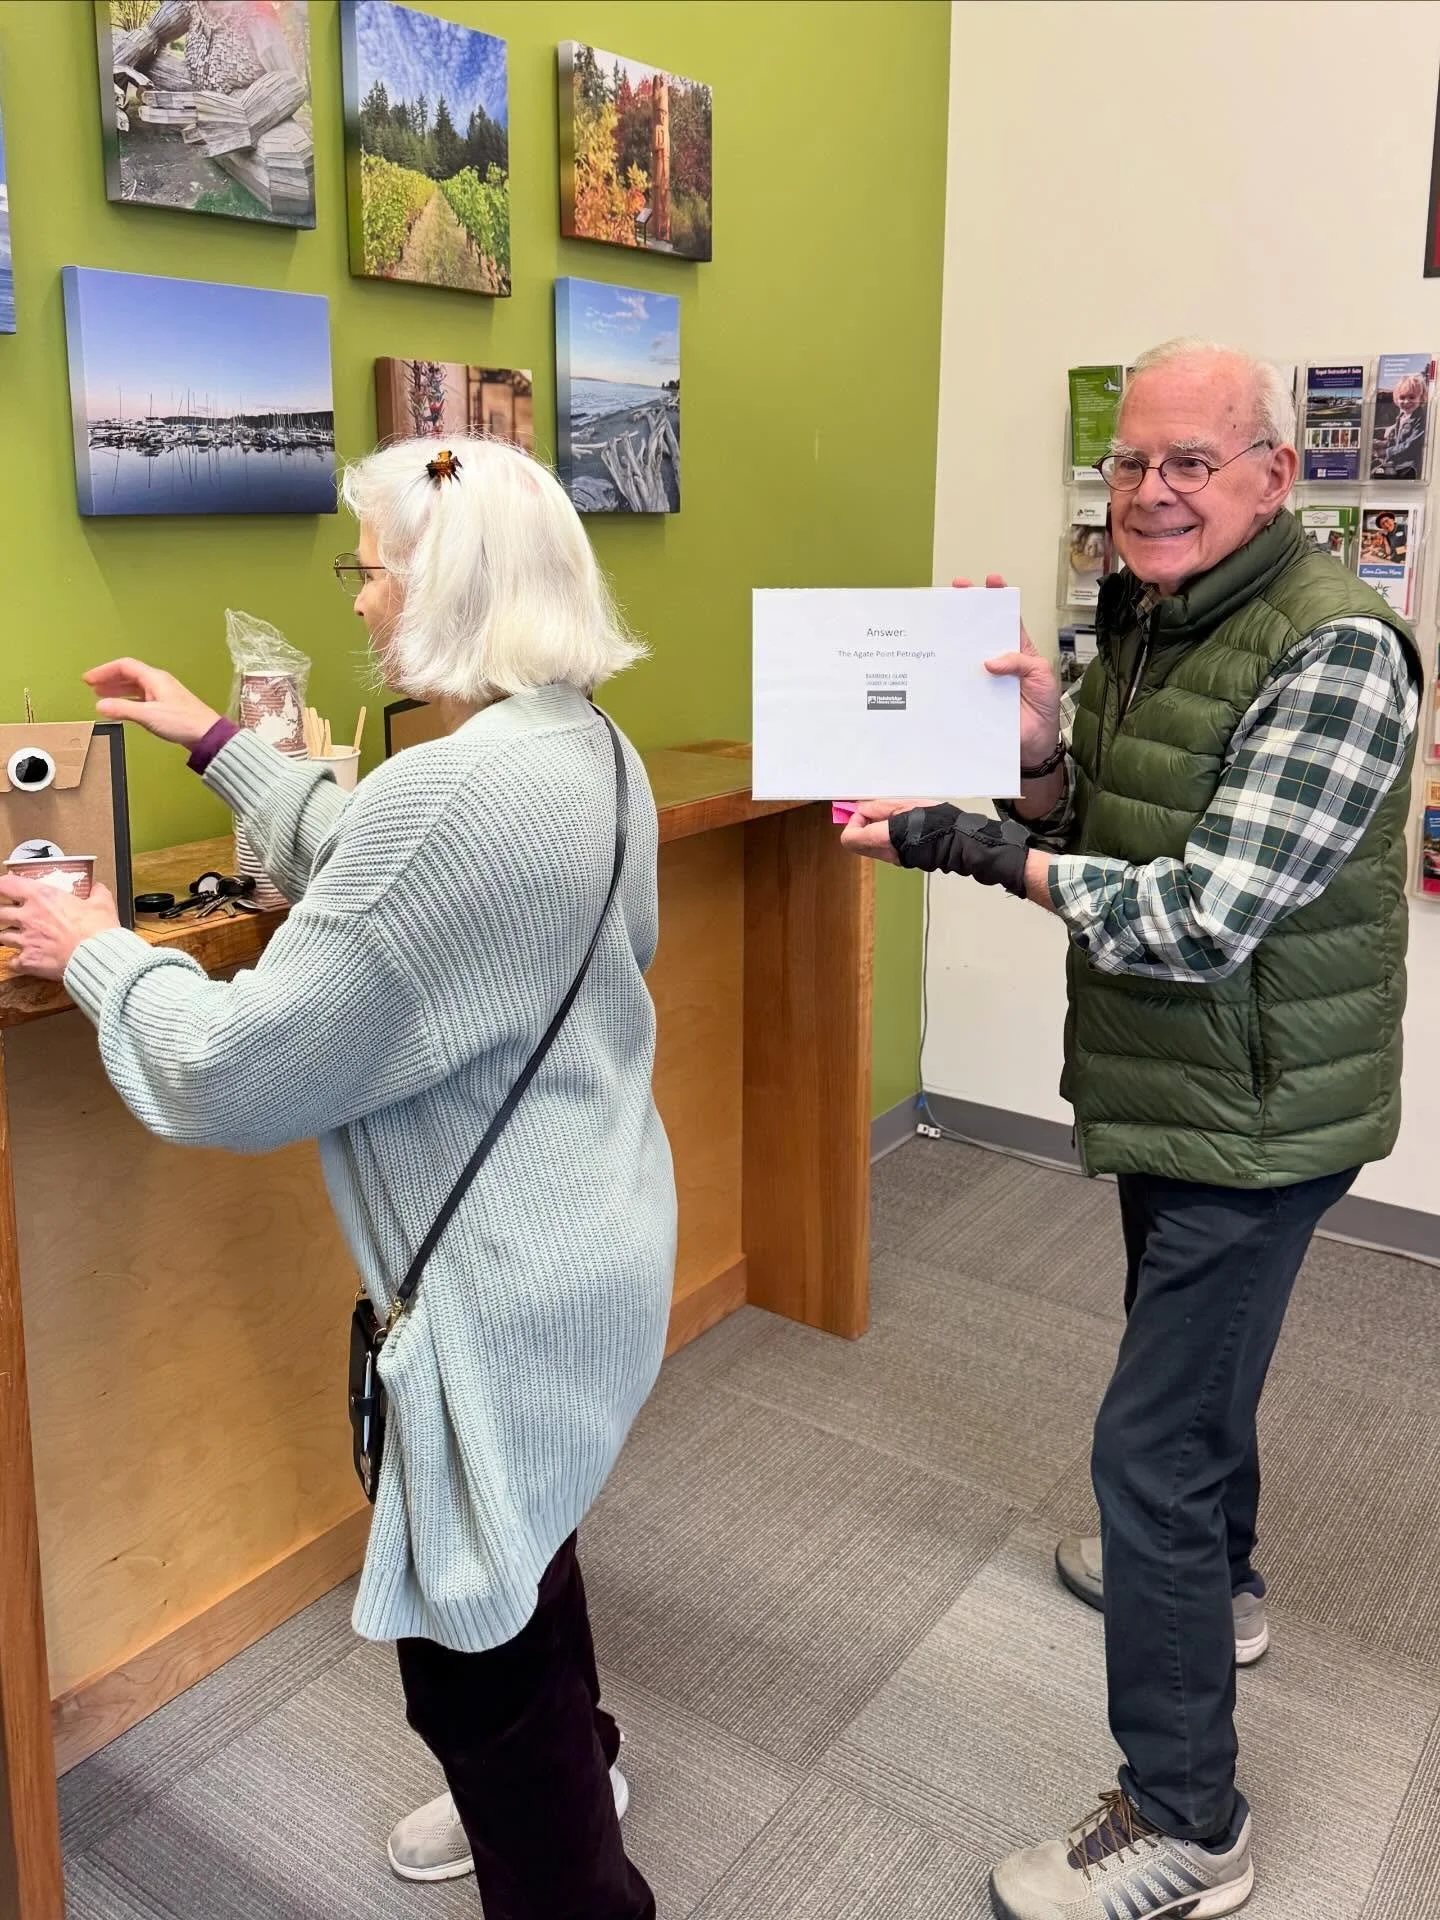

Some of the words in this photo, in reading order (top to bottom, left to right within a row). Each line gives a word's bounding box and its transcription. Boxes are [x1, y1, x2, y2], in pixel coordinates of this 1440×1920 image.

[866, 627, 908, 637] Answer:
[853, 650, 874, 659] Agate
[896, 650, 936, 659] Petroglyph
